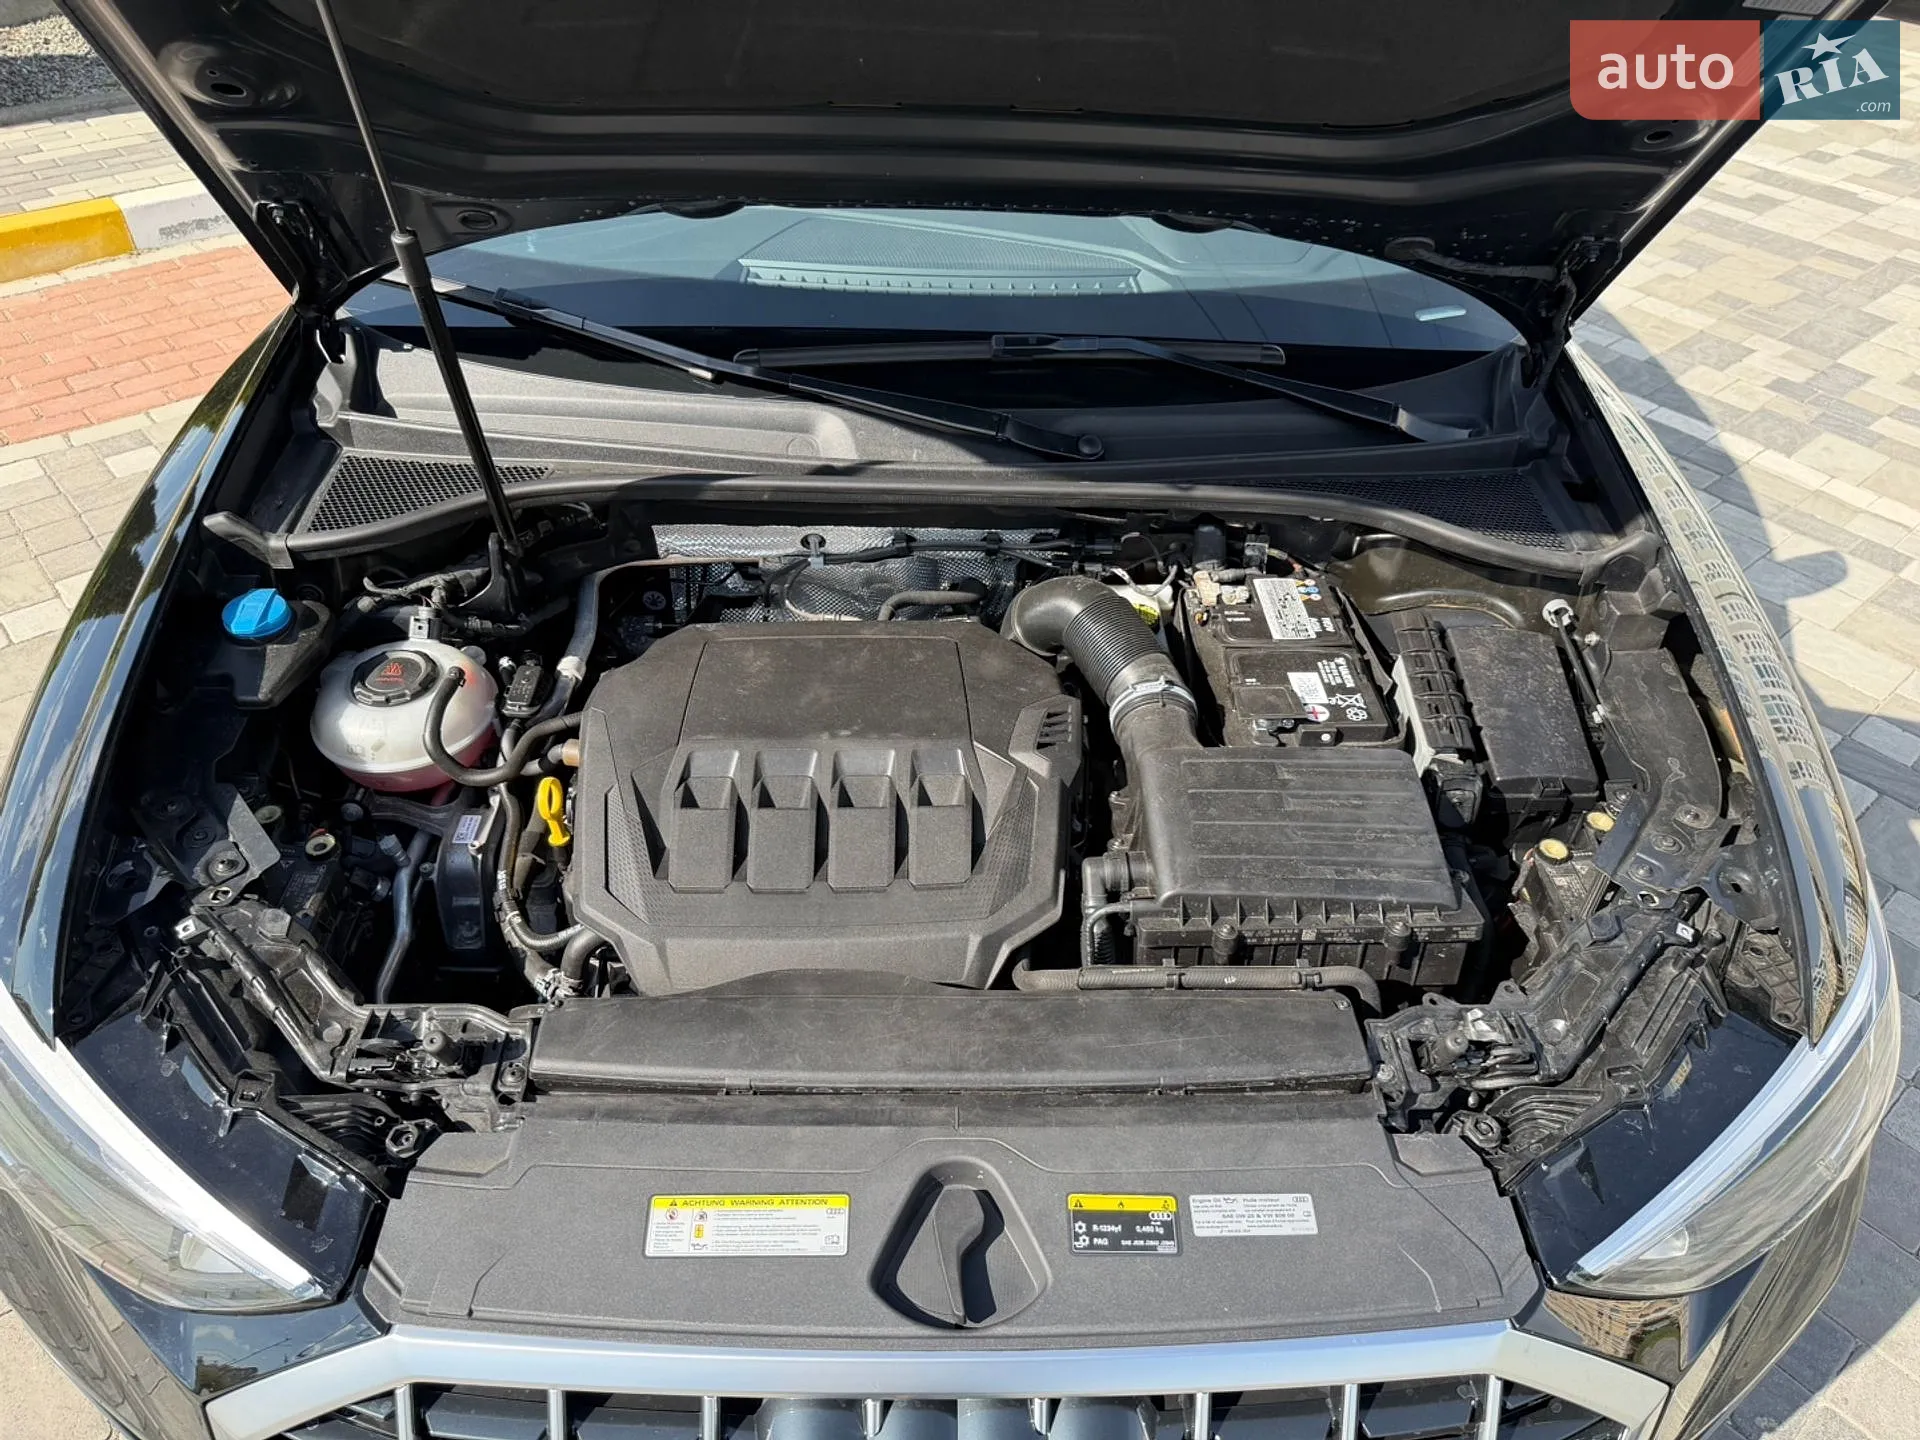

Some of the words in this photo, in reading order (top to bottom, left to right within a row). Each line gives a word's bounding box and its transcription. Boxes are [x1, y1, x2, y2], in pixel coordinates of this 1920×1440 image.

[682, 1199, 725, 1207] ACHTUNG
[779, 1198, 829, 1206] ATTENTION
[1093, 1237, 1109, 1246] PAG
